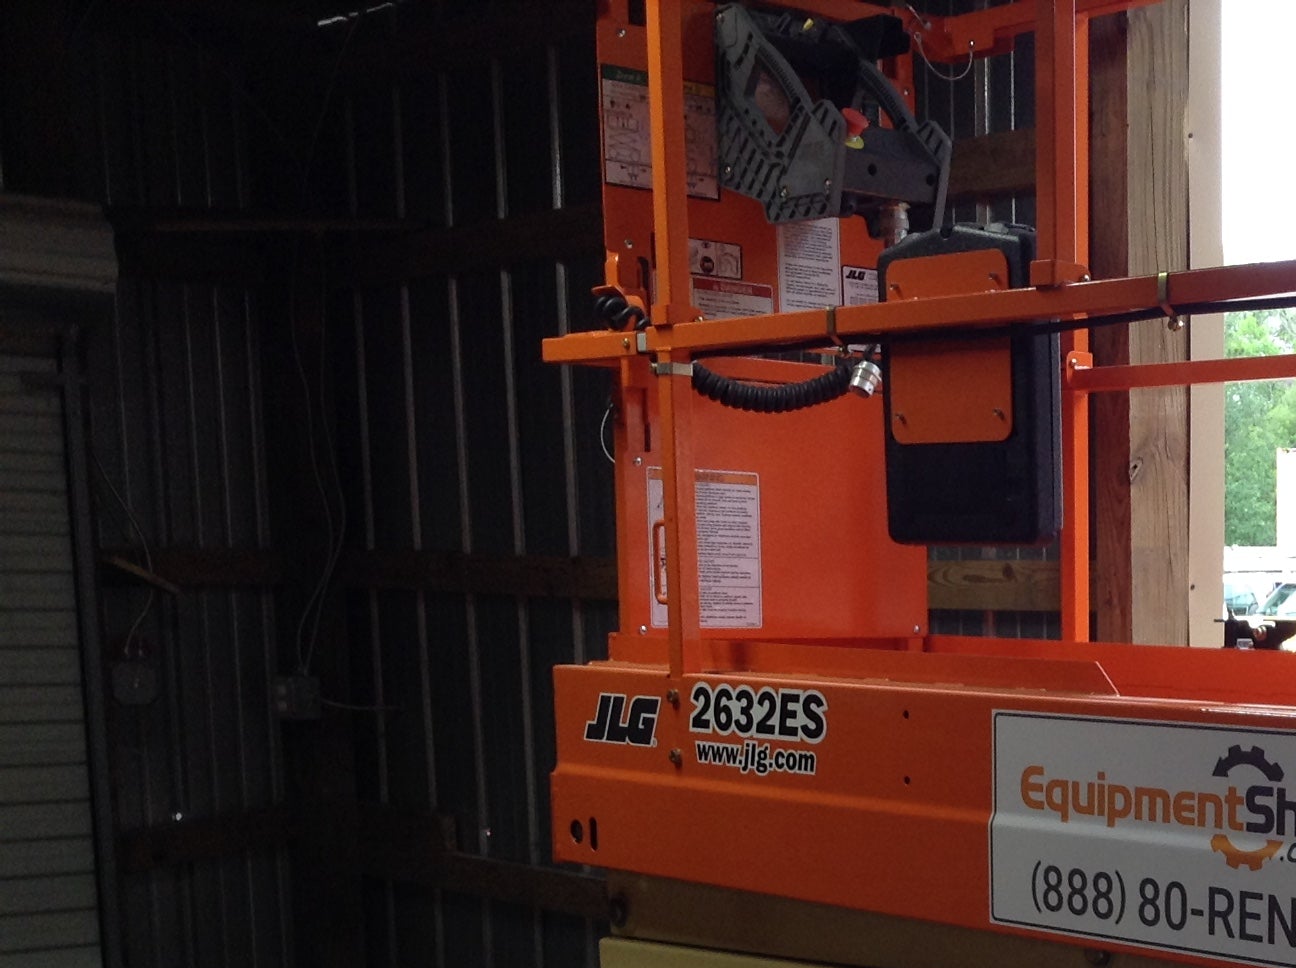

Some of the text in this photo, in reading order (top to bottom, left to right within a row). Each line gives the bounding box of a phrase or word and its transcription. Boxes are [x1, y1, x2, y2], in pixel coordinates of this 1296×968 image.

[585, 693, 660, 746] JLG
[690, 684, 827, 742] 2632ES
[696, 741, 817, 775] www.jlg.com
[1031, 859, 1126, 926] (888)
